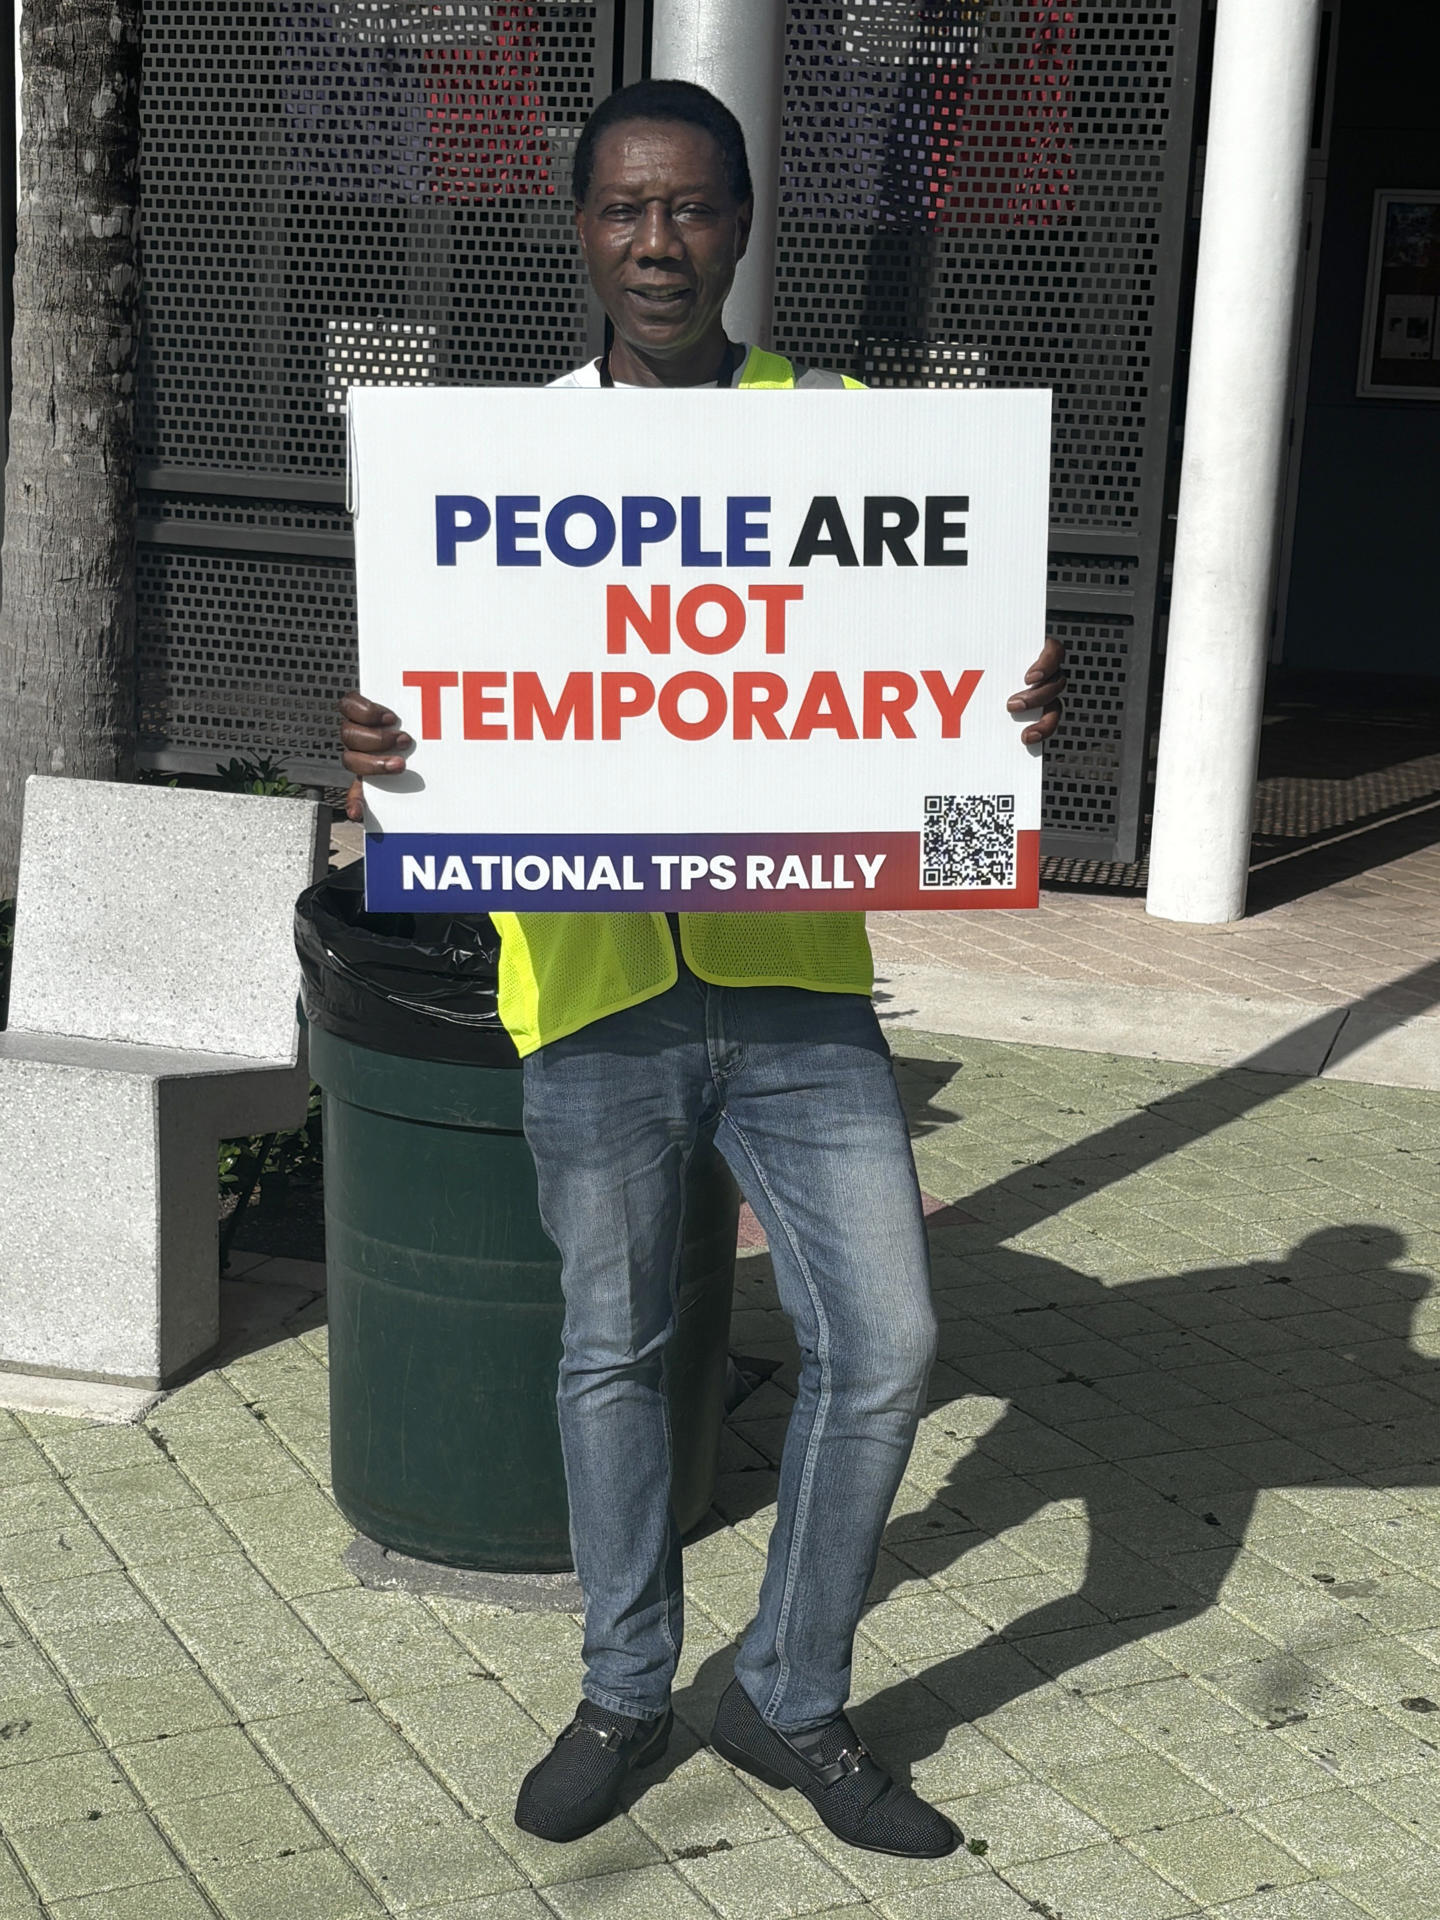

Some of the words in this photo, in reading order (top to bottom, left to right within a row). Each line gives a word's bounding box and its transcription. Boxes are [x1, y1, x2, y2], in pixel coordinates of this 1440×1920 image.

[436, 495, 771, 567] PEOPLE
[789, 496, 969, 567] ARE
[607, 584, 803, 655] NOT
[403, 670, 984, 741] TEMPORARY
[403, 856, 643, 890] NATIONAL
[652, 855, 736, 890] TPS
[747, 855, 886, 889] RALLY
